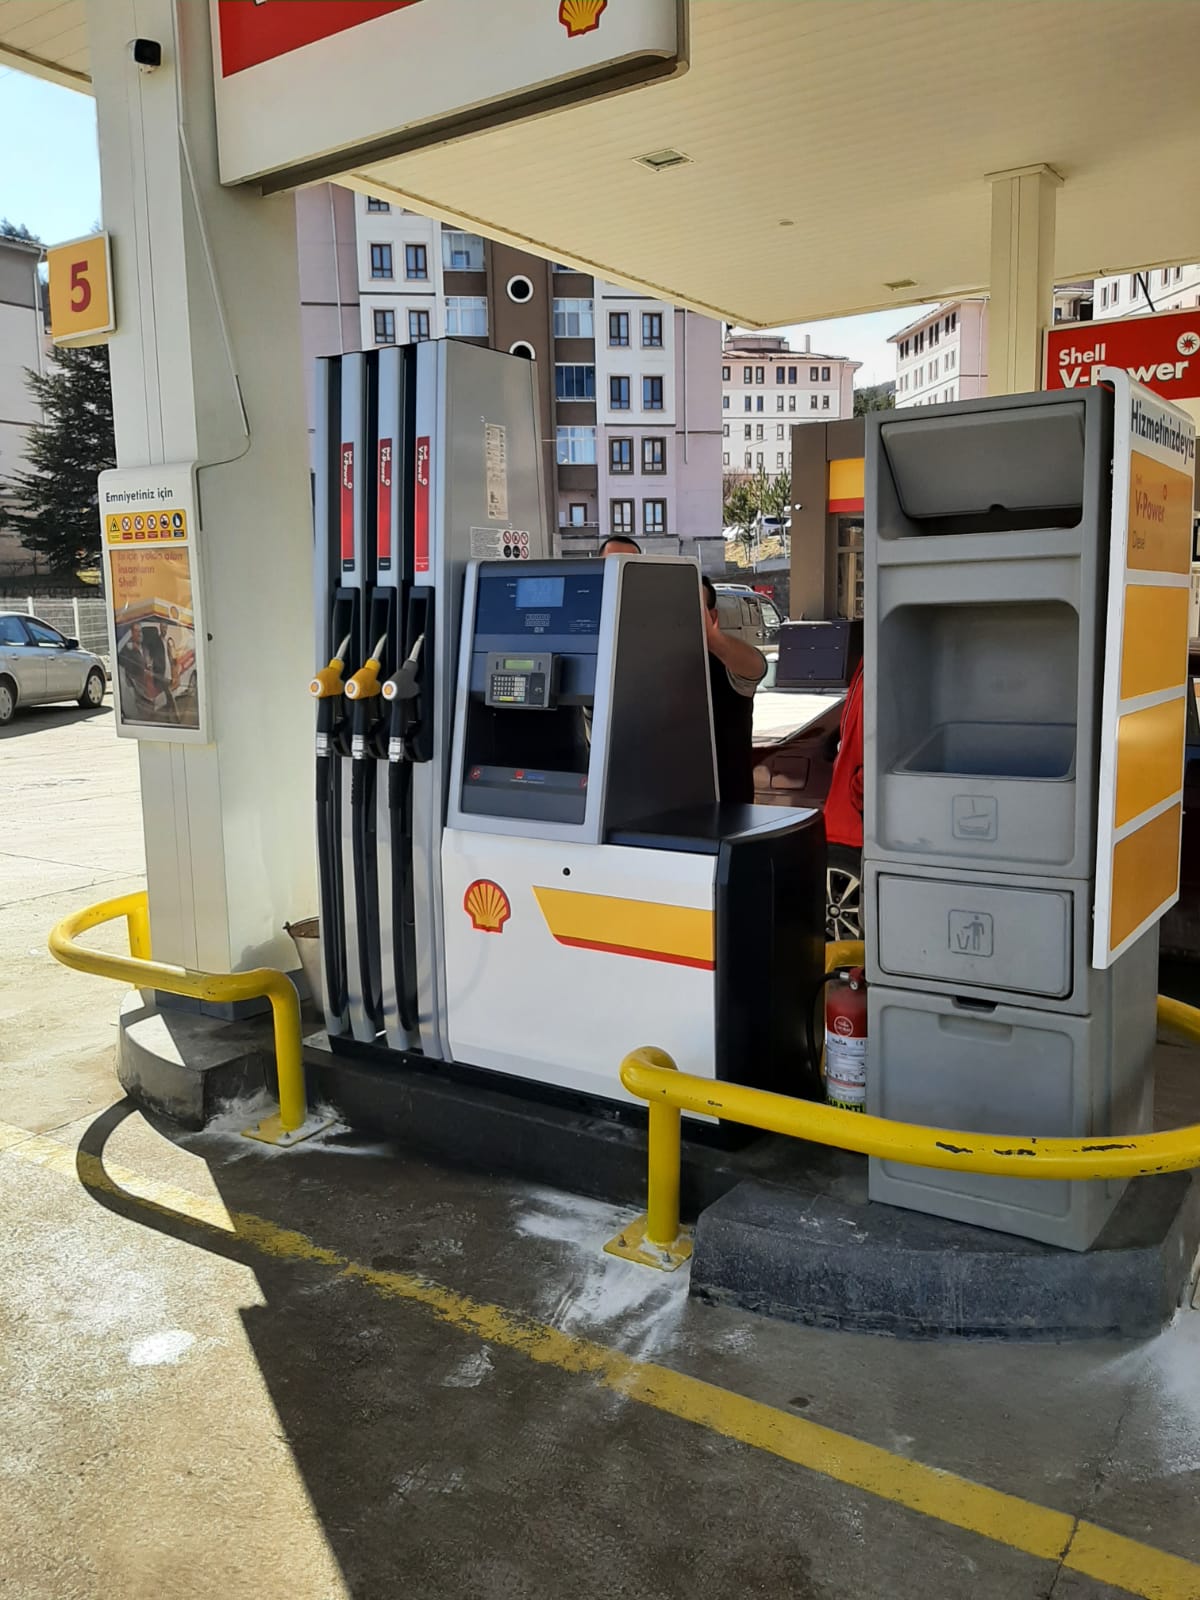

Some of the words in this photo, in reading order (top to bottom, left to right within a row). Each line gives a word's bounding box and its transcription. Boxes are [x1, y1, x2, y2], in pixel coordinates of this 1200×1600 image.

[71, 260, 92, 313] 5
[1058, 343, 1106, 366] Shell
[1059, 361, 1189, 389] V-Pwer
[1131, 398, 1195, 465] Hizmetinizdeyiz
[105, 488, 154, 504] Emniyetiniz
[157, 487, 173, 501] için
[1135, 489, 1165, 523] V-Power
